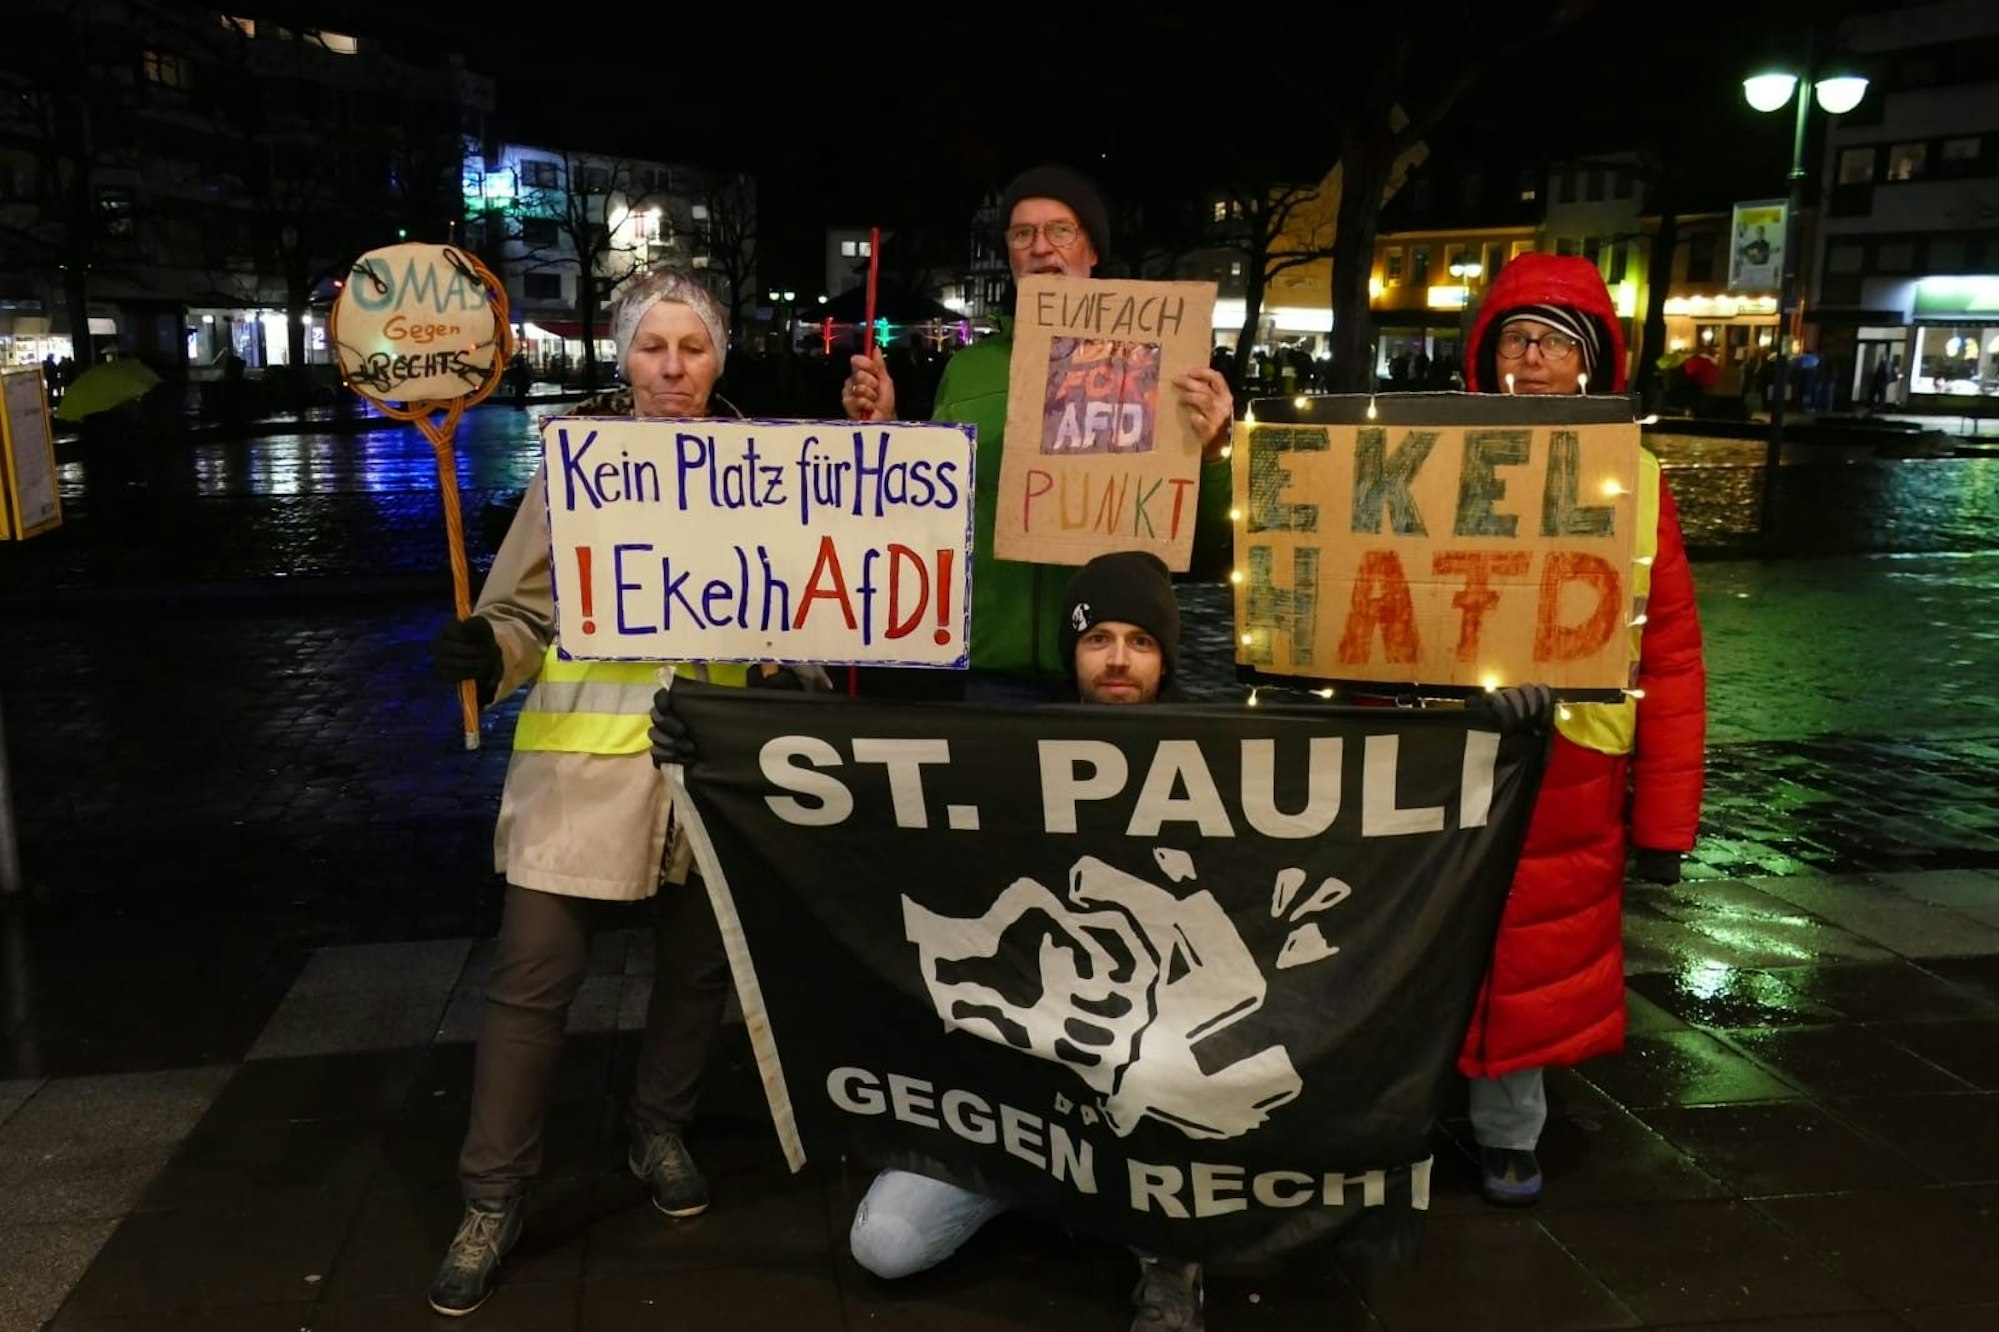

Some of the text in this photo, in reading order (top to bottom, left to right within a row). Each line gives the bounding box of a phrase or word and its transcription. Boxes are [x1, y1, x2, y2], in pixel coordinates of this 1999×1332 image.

[351, 256, 488, 313] OMAS
[1037, 291, 1185, 337] EINFACH
[382, 315, 461, 344] Gegen
[366, 349, 470, 381] RECHTS
[1053, 400, 1144, 450] AFD
[558, 429, 660, 511] Kein
[675, 432, 788, 511] Platz
[1247, 427, 1616, 538] EKEL
[1023, 469, 1195, 541] PUNKT
[758, 730, 1501, 839] ST. PAULI
[826, 1066, 1099, 1194] GEGEN
